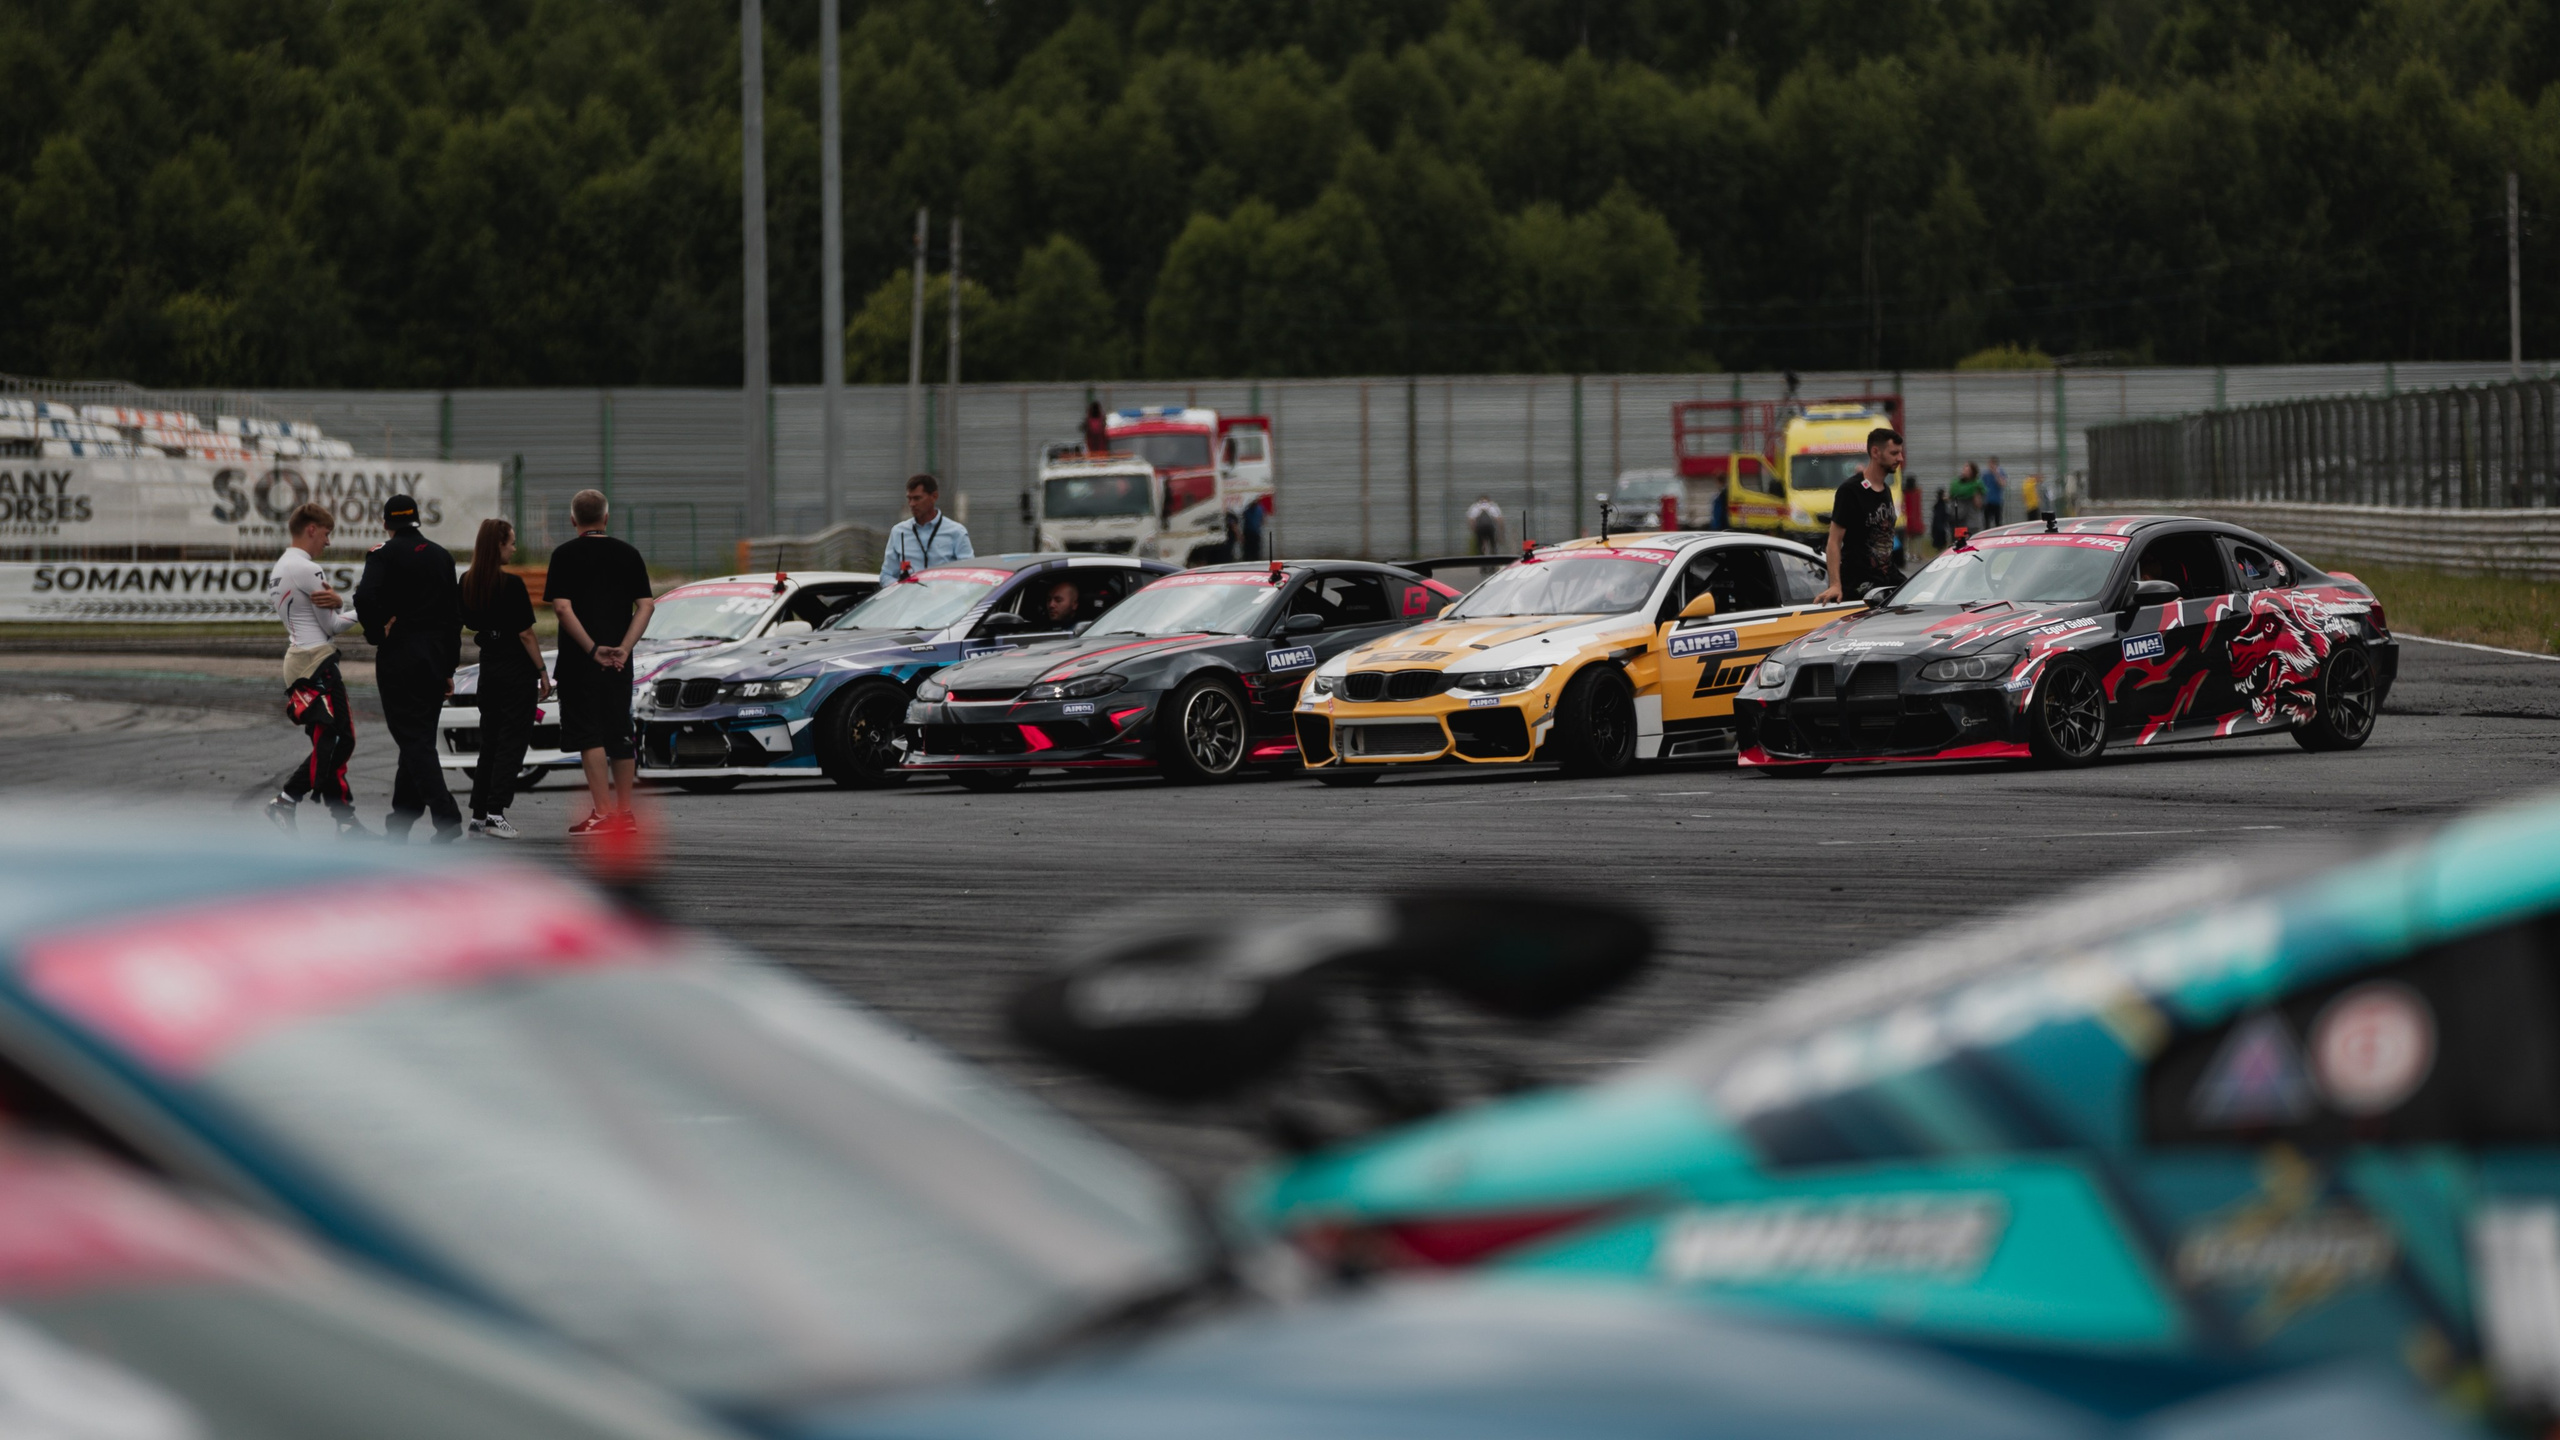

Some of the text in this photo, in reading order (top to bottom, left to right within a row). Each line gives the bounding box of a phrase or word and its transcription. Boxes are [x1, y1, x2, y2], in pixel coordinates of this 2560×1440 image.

[2041, 617, 2097, 636] Egor Gubin
[1672, 632, 1736, 655] AIMOL
[2126, 637, 2163, 658] AIMOL
[1270, 651, 1314, 669] AIMOL
[743, 683, 763, 697] 10
